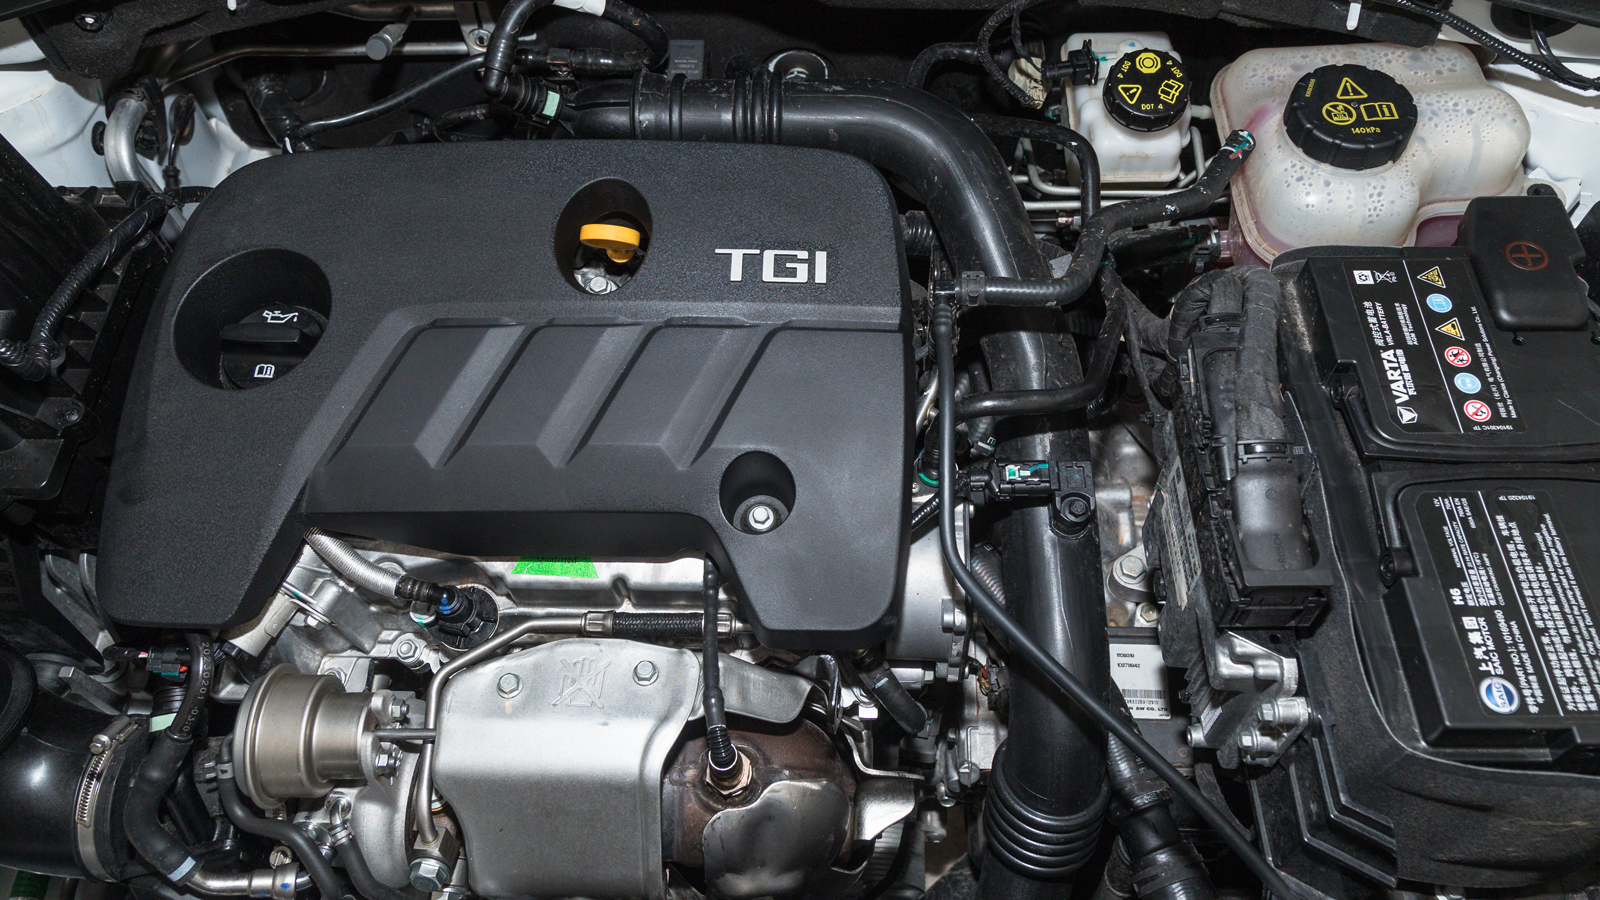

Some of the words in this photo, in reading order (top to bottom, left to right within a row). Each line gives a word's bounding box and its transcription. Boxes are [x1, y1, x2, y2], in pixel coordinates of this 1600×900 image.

[1120, 60, 1132, 72] DOT
[1170, 66, 1183, 78] DOT
[1350, 126, 1381, 134] 140kPa
[714, 248, 827, 284] TGI
[1375, 302, 1394, 345] VRLA-BATTERY
[1401, 304, 1414, 332] Technology
[1410, 333, 1418, 345] AGM
[1485, 343, 1493, 356] Power
[1380, 349, 1409, 404] VARTA
[1509, 406, 1517, 418] Made
[1452, 521, 1464, 543] CAPACITY
[1543, 513, 1557, 536] terminal.
[1443, 526, 1454, 546] VOLTAGE
[1534, 533, 1546, 551] except
[1540, 524, 1553, 547] negative
[1554, 536, 1565, 555] battery
[1273, 534, 1288, 564] BOSCH
[1451, 548, 1461, 568] NOMINAL
[1550, 548, 1561, 567] charge
[1482, 553, 1491, 566] AMPS
[1543, 552, 1554, 571] battery
[1561, 557, 1569, 566] the
[1487, 567, 1500, 591] CRANKING
[1550, 573, 1558, 582] the
[1565, 567, 1574, 580] onto
[1450, 588, 1464, 605] H6
[1496, 592, 1505, 605] COLD
[1554, 583, 1571, 614] disconnect
[1560, 576, 1578, 604] jump-start
[1572, 586, 1586, 608] connect
[1566, 615, 1576, 624] not
[1572, 606, 1580, 615] the
[1477, 617, 1496, 650] MOTOR
[1494, 610, 1513, 644] 10169490
[1510, 621, 1523, 642] CHINA
[1576, 616, 1590, 640] connect
[1462, 616, 1497, 675] 上汽集团
[1575, 635, 1587, 653] failure
[1586, 640, 1597, 656] Only
[1490, 652, 1504, 675] SAIC
[1520, 653, 1534, 673] MADE
[1495, 682, 1508, 708] SAIC
[1528, 675, 1544, 703] 中国制造
